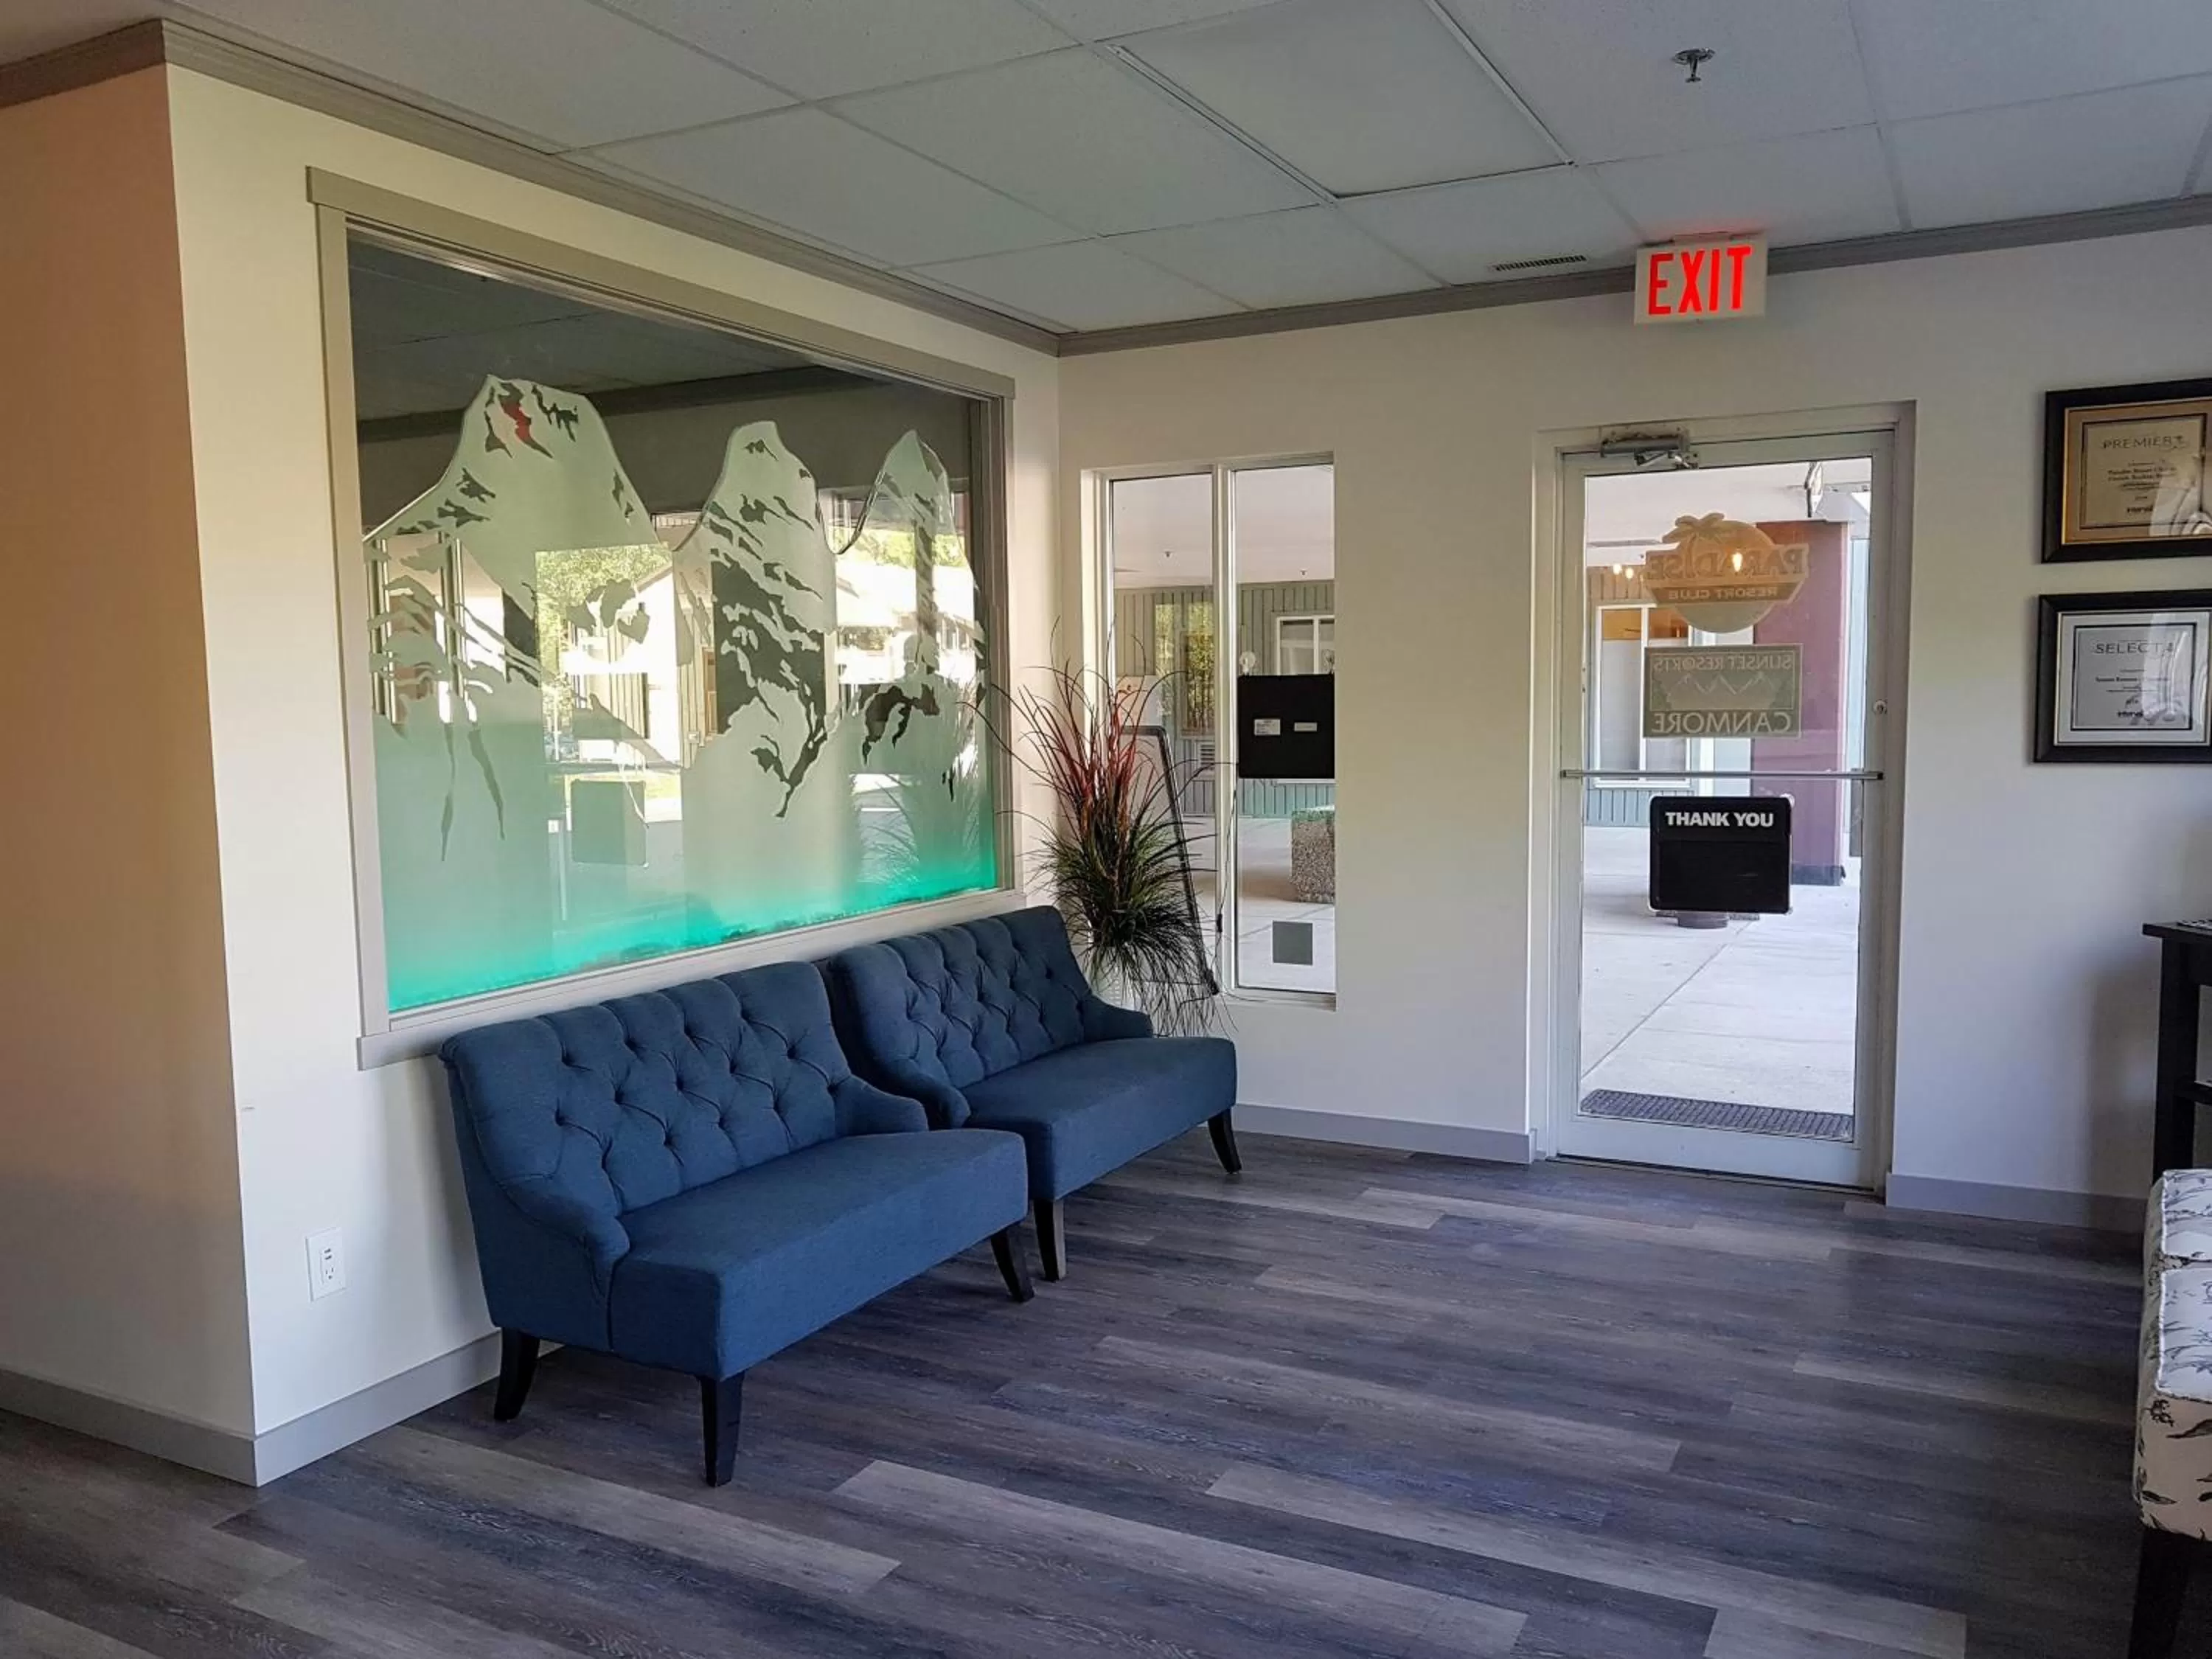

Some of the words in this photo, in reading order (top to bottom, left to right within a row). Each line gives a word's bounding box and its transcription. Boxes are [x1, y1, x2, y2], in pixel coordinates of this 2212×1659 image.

[1648, 245, 1753, 316] EXIT
[2094, 642, 2163, 655] SELECT
[1665, 812, 1730, 827] THANK
[1734, 813, 1774, 827] YOU
